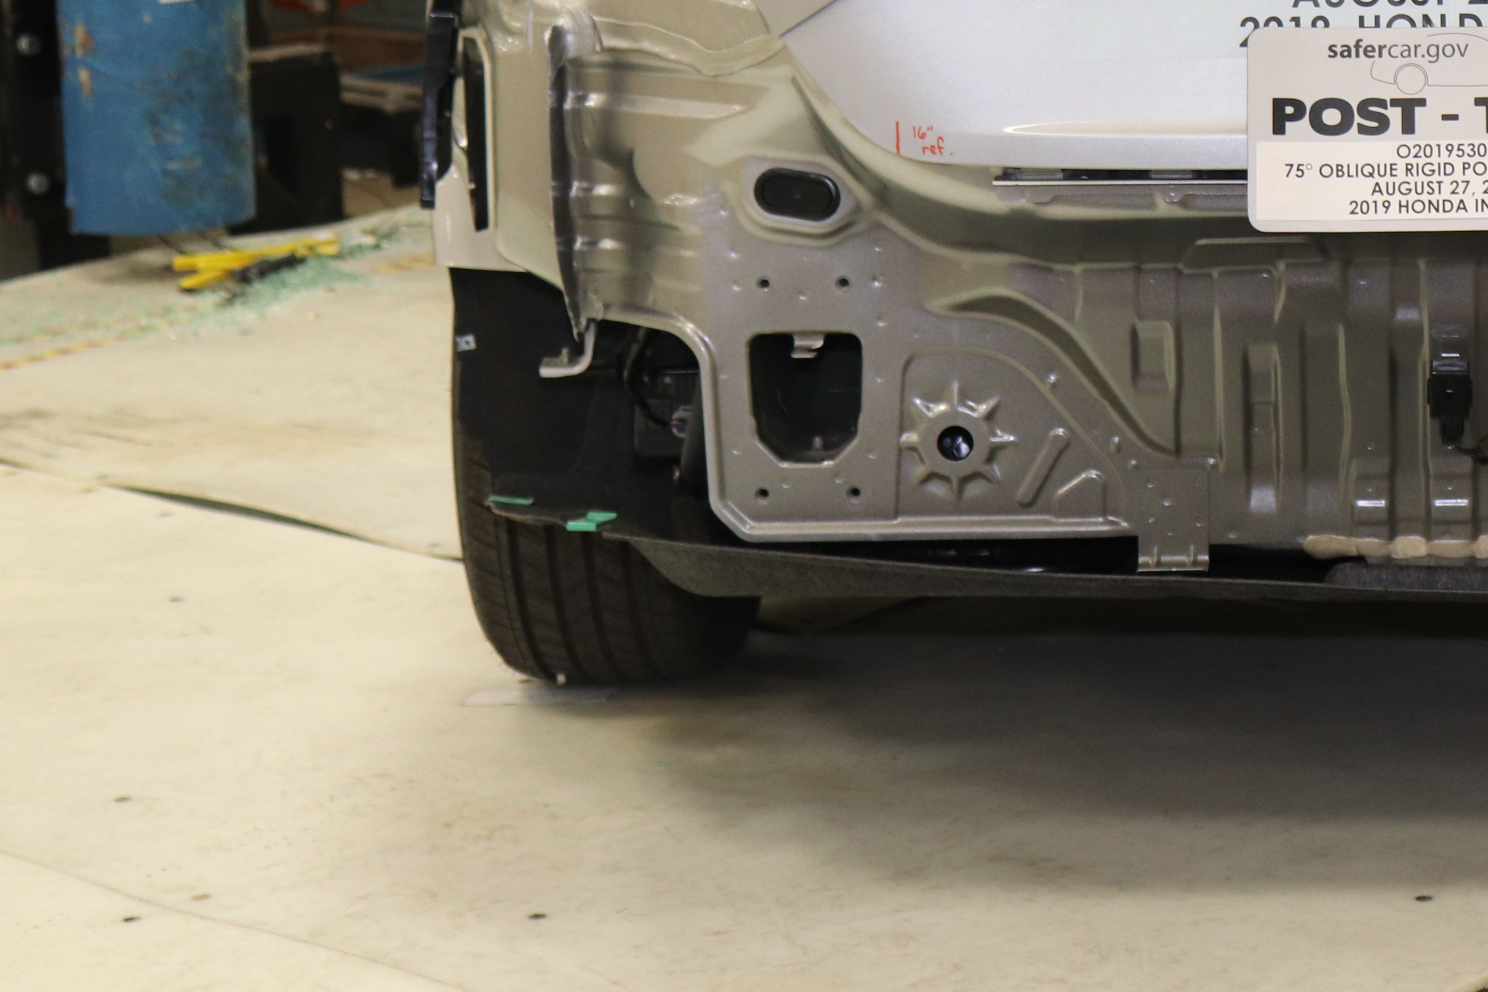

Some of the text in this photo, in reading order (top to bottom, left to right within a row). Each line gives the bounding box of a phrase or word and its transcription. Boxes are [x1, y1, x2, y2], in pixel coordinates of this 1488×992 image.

[1328, 38, 1469, 63] safercar.gov
[1272, 97, 1427, 136] POST
[1284, 162, 1314, 178] 75°
[1319, 162, 1398, 179] OBLIQUE
[1405, 161, 1455, 177] RIGID
[1370, 180, 1444, 196] AUGUST
[1449, 180, 1476, 197] 27,
[1349, 199, 1391, 215] 2019
[1398, 198, 1468, 214] HONDA
